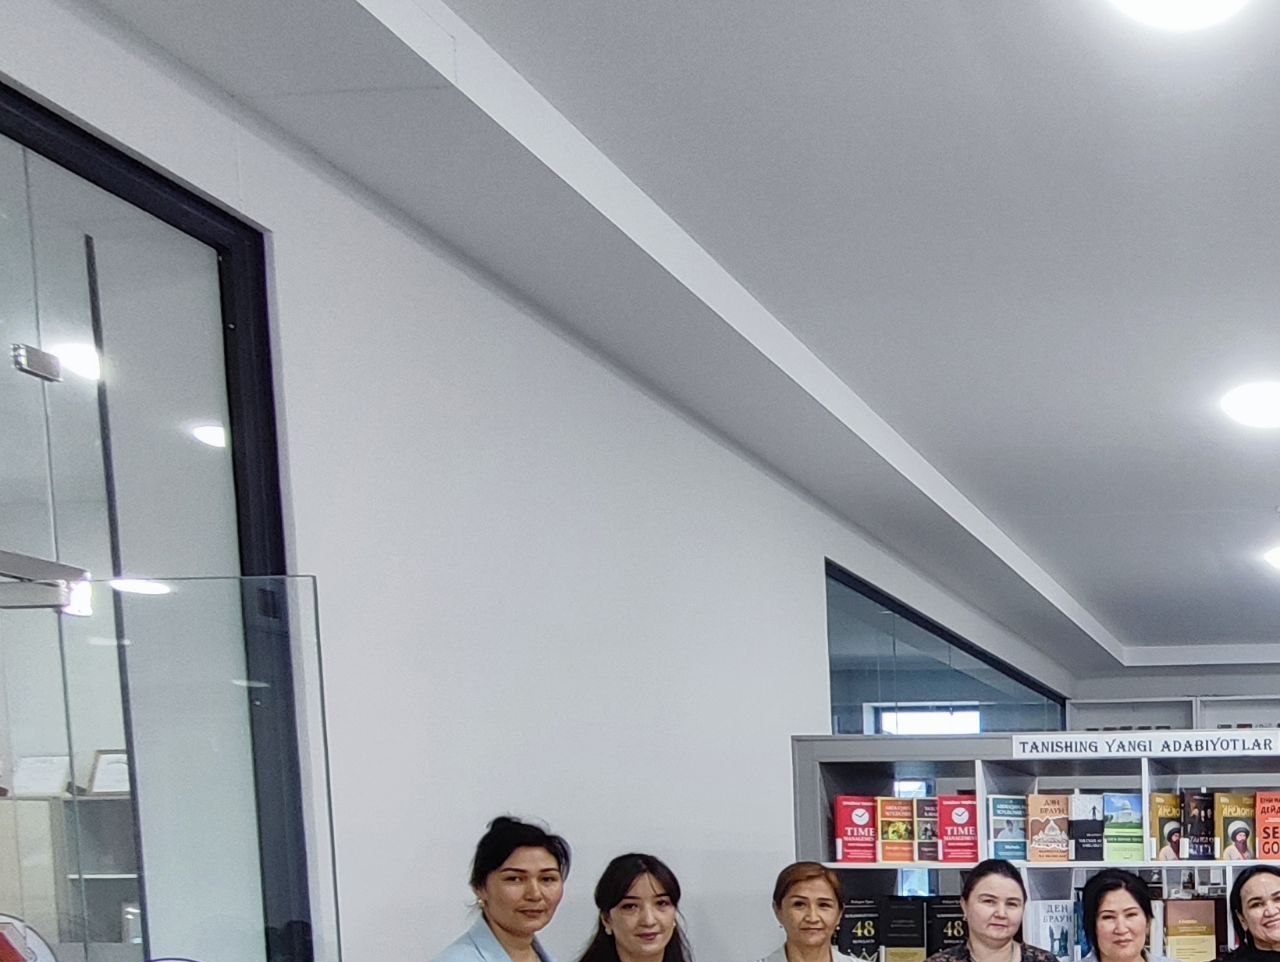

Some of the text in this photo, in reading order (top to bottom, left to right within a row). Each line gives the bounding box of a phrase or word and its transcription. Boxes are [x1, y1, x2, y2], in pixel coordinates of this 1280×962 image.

[1019, 737, 1273, 753] TANISHING YANGI ADABIYOTLAR
[845, 827, 875, 836] TIME
[944, 826, 976, 835] TIME
[851, 920, 875, 937] 48
[943, 920, 964, 937] 48
